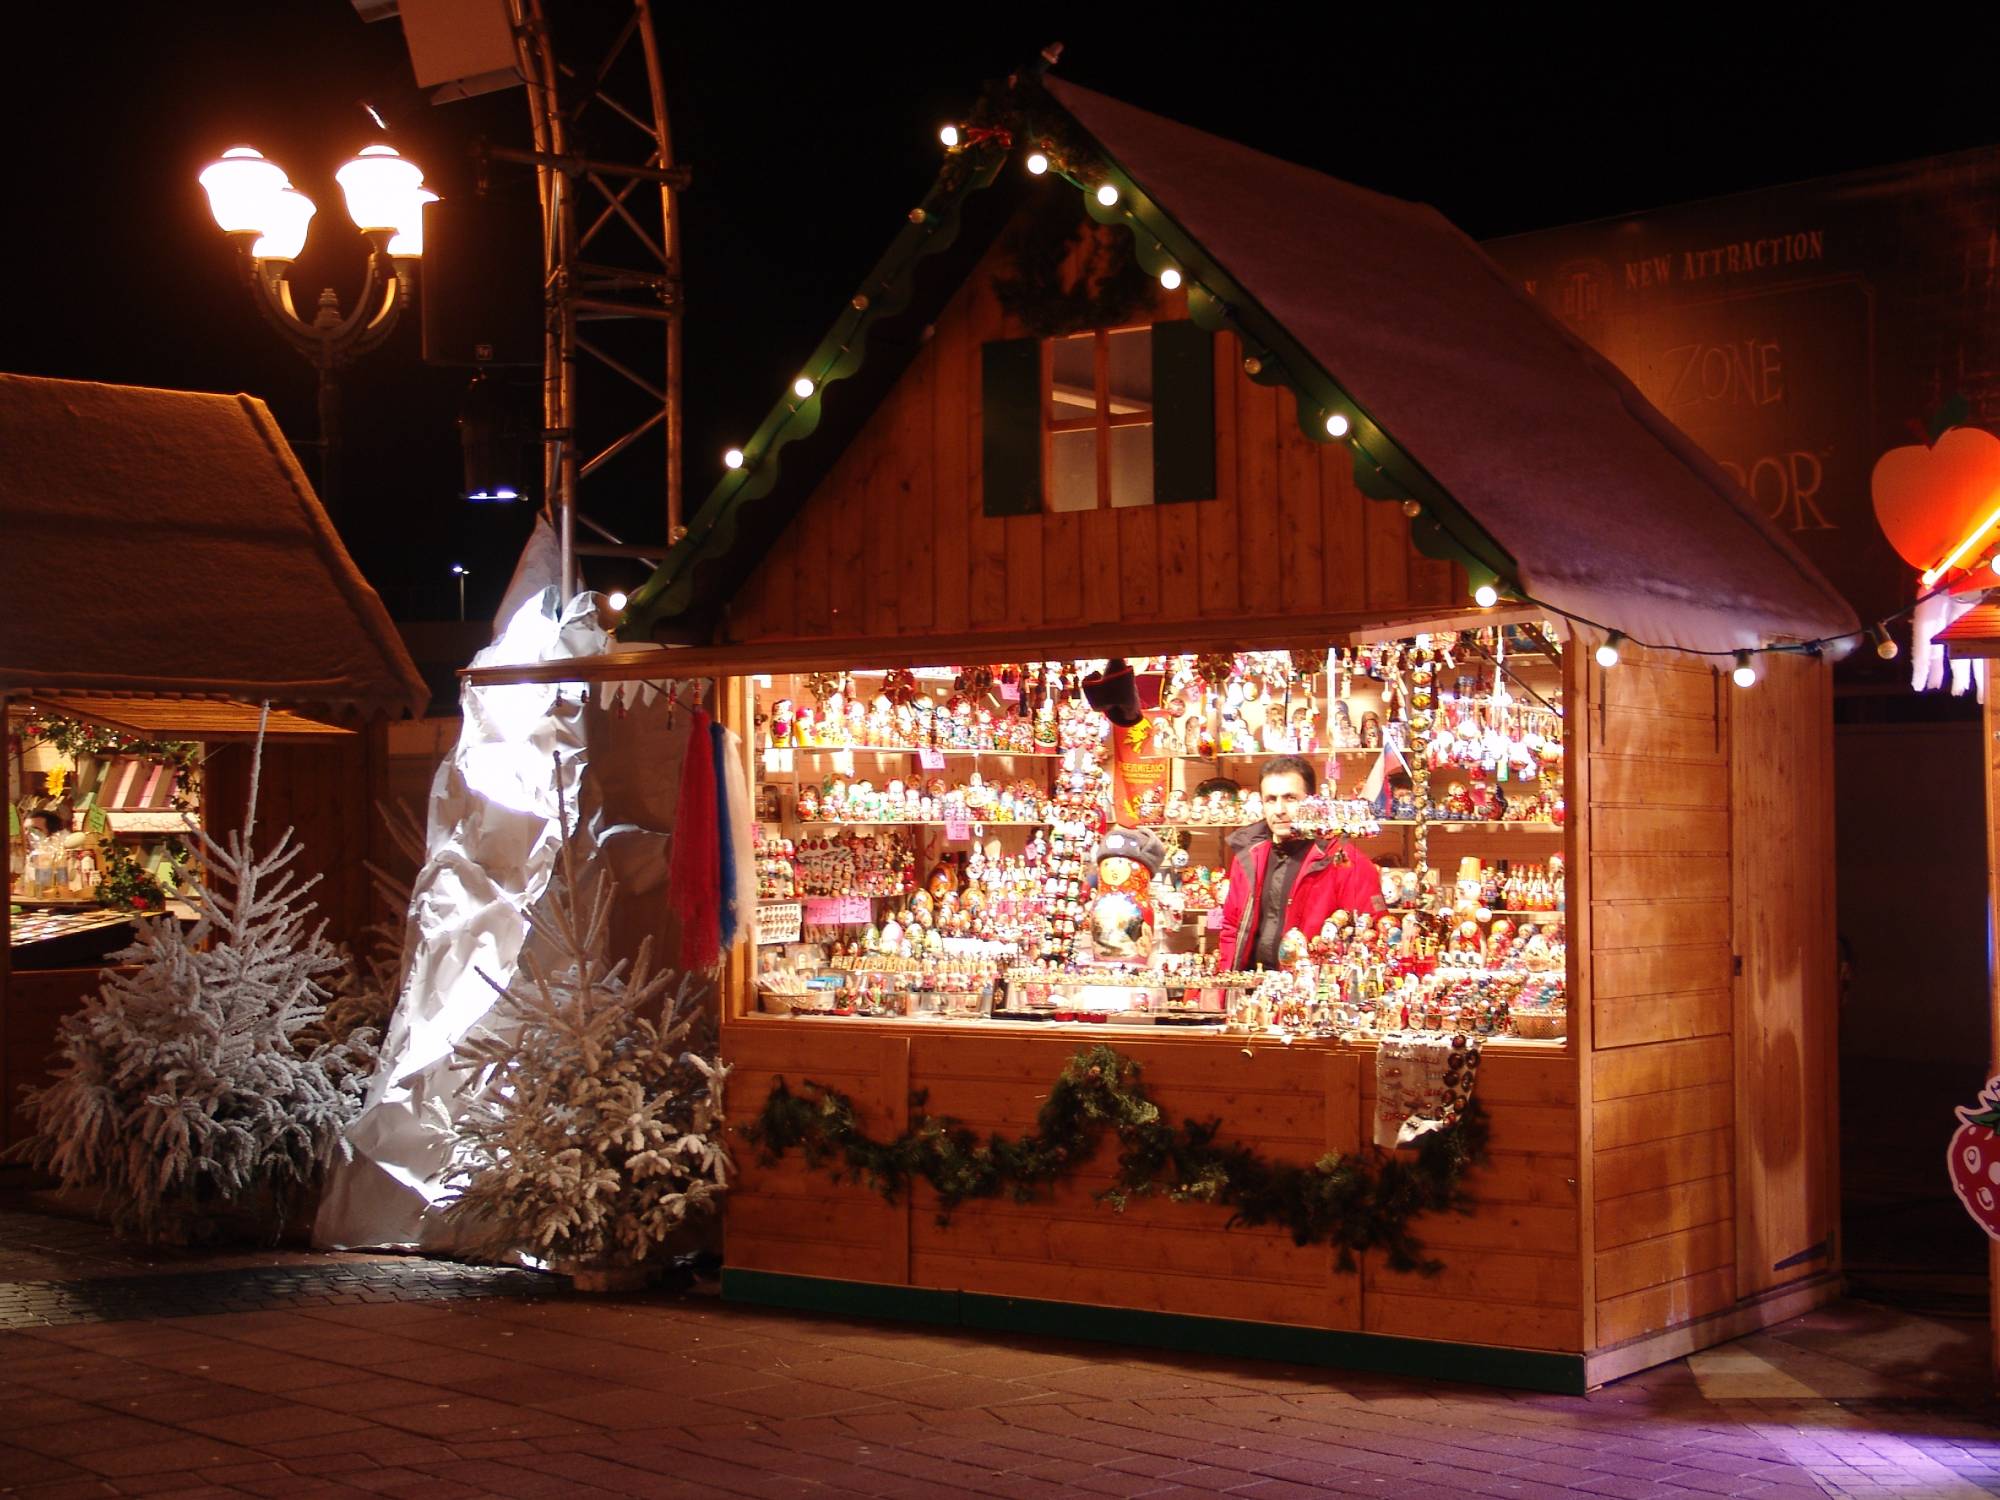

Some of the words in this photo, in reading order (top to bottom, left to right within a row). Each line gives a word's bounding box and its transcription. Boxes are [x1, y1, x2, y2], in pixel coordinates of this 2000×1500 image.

[1626, 255, 1671, 288] NEW
[1683, 231, 1823, 280] ATTRACTION
[1663, 338, 1782, 407] ZONE
